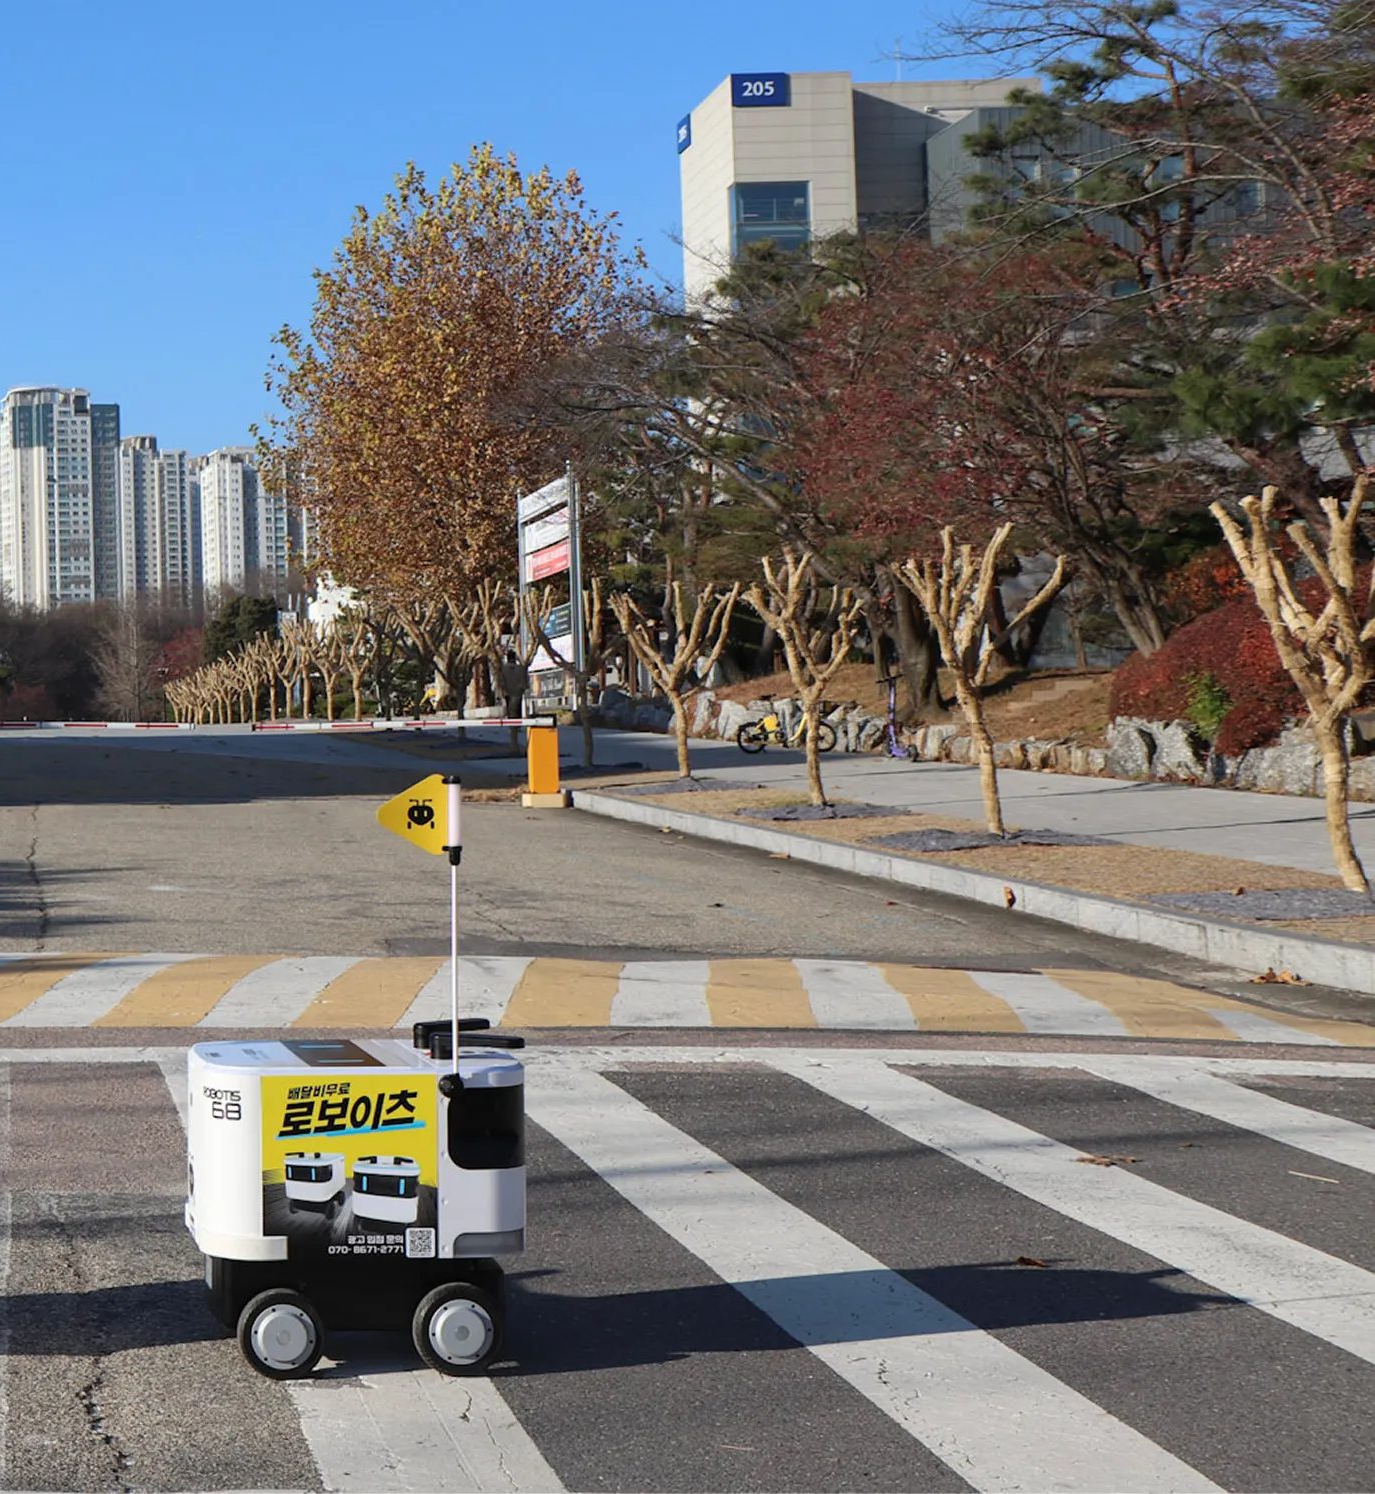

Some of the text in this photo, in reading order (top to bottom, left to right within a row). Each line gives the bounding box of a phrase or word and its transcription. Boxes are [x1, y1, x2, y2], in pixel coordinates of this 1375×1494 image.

[741, 81, 775, 96] 205
[287, 1082, 351, 1100] 배달비무료
[212, 1101, 242, 1121] 68
[278, 1090, 418, 1137] 로보이츠
